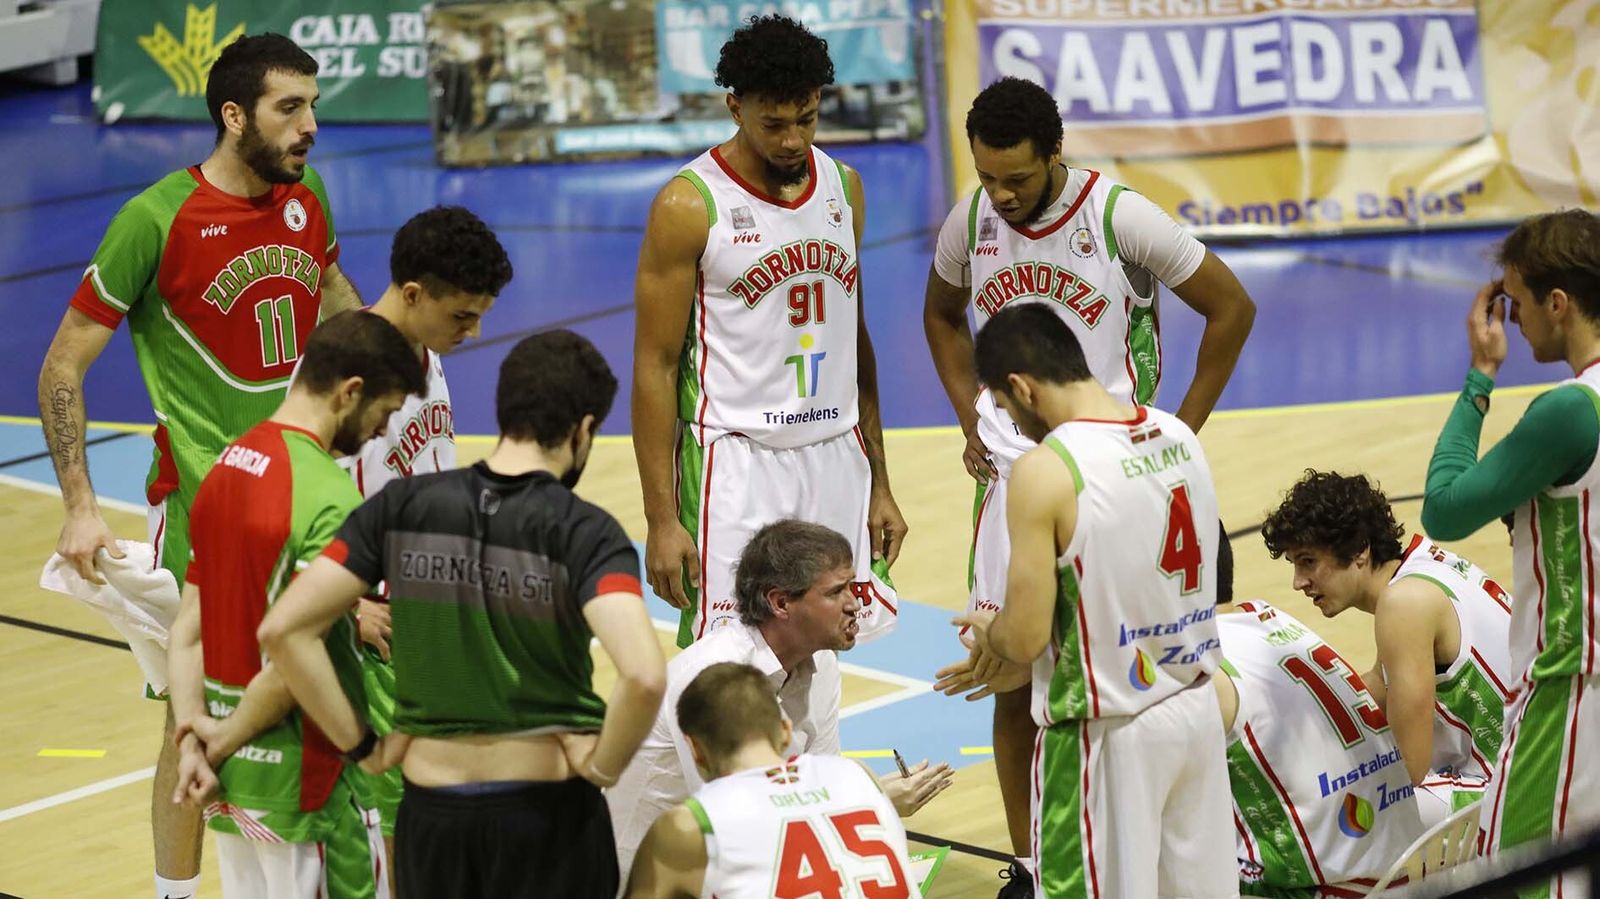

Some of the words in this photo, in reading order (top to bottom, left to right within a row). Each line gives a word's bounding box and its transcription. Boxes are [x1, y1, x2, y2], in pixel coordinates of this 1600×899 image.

[289, 13, 381, 47] CAJA
[305, 46, 366, 79] EL
[993, 19, 1473, 114] SAAVEDRA
[1177, 196, 1342, 226] Siempre
[202, 244, 321, 315] ZORNOTZA
[727, 239, 858, 310] ZORNOTZA
[787, 279, 826, 328] 91
[974, 260, 1112, 331] ZORNOTZA
[254, 295, 298, 368] 11
[763, 406, 839, 425] Trienekens
[1156, 479, 1204, 597] 4
[521, 574, 553, 602] ST
[1278, 643, 1390, 750] 13
[770, 807, 911, 899] 45
